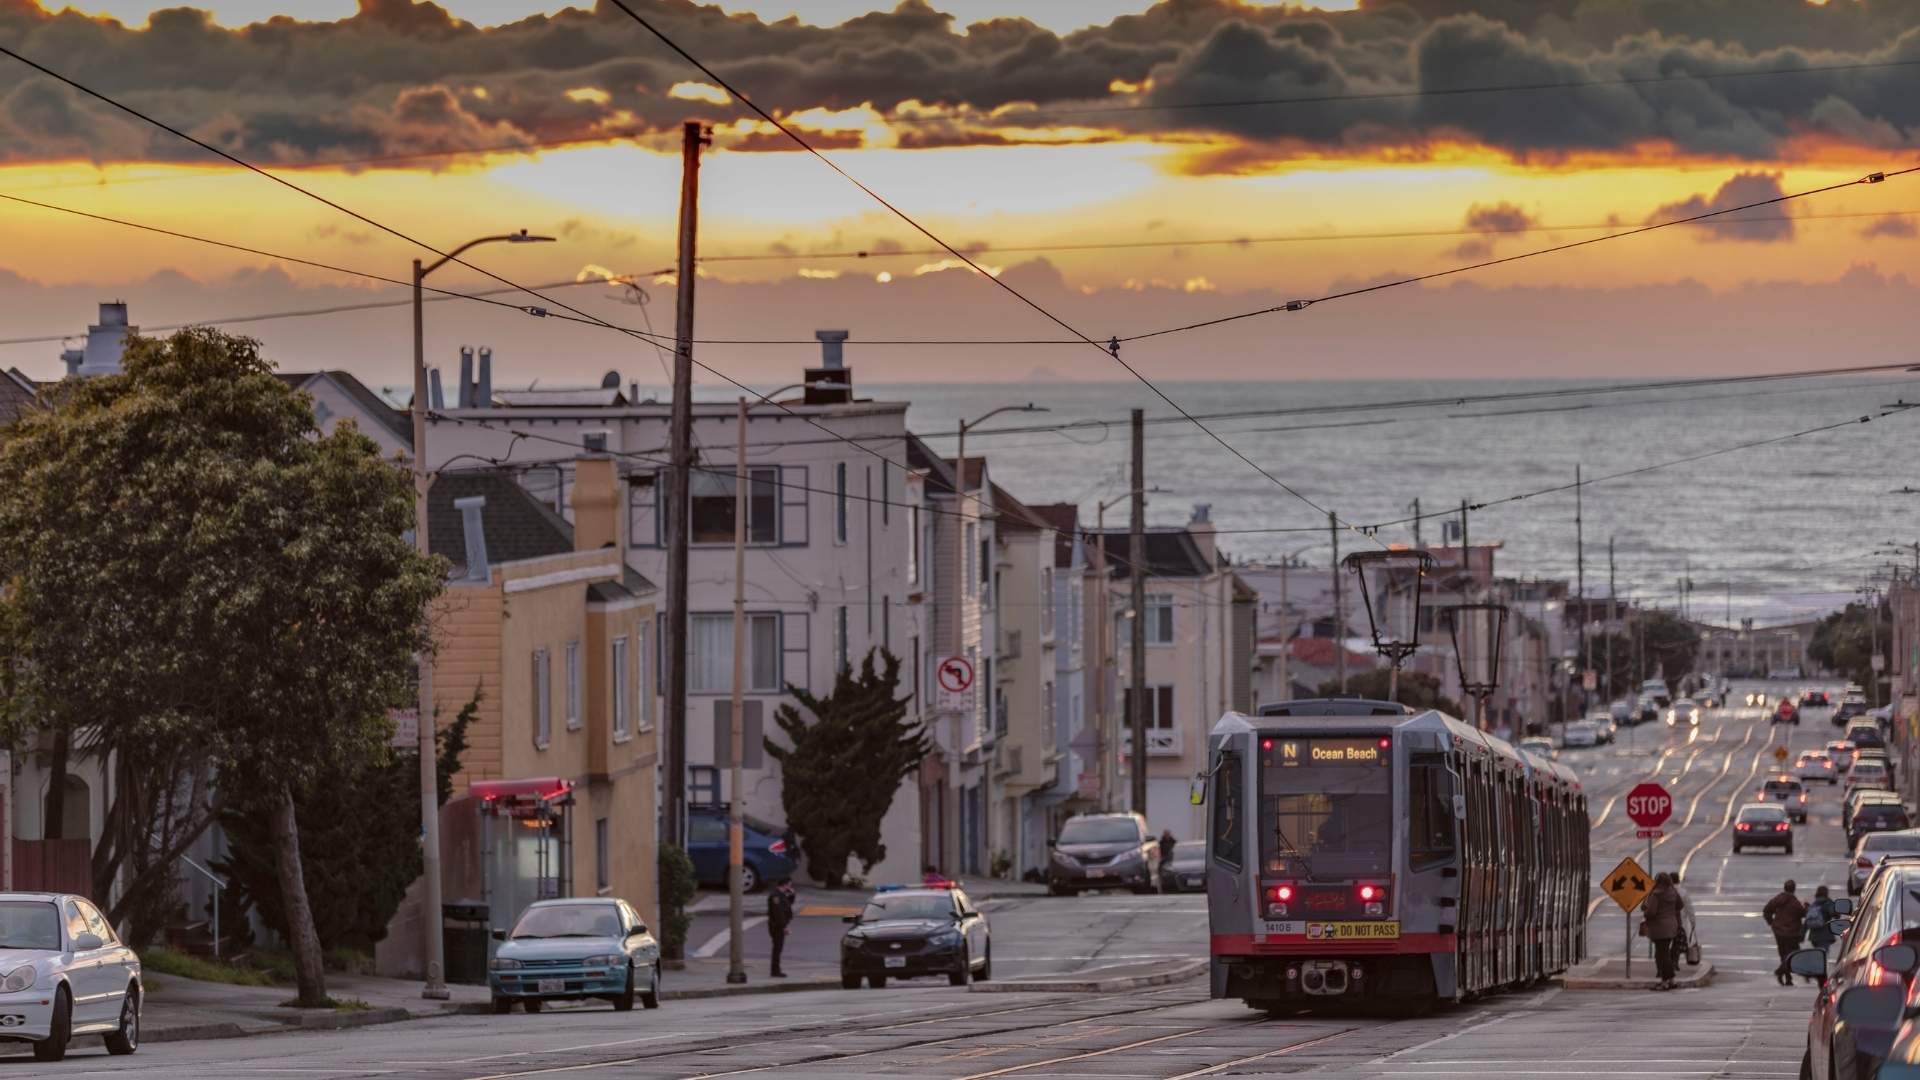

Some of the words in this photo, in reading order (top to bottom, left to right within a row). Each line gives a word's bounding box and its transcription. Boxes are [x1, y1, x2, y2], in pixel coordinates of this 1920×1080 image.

[1284, 743, 1297, 758] N
[1312, 747, 1343, 760] Ocean
[1346, 747, 1377, 760] Beach
[1630, 796, 1670, 815] STOP
[1340, 925, 1352, 936] DO
[1355, 925, 1371, 936] NOT
[1374, 924, 1395, 935] PASS
